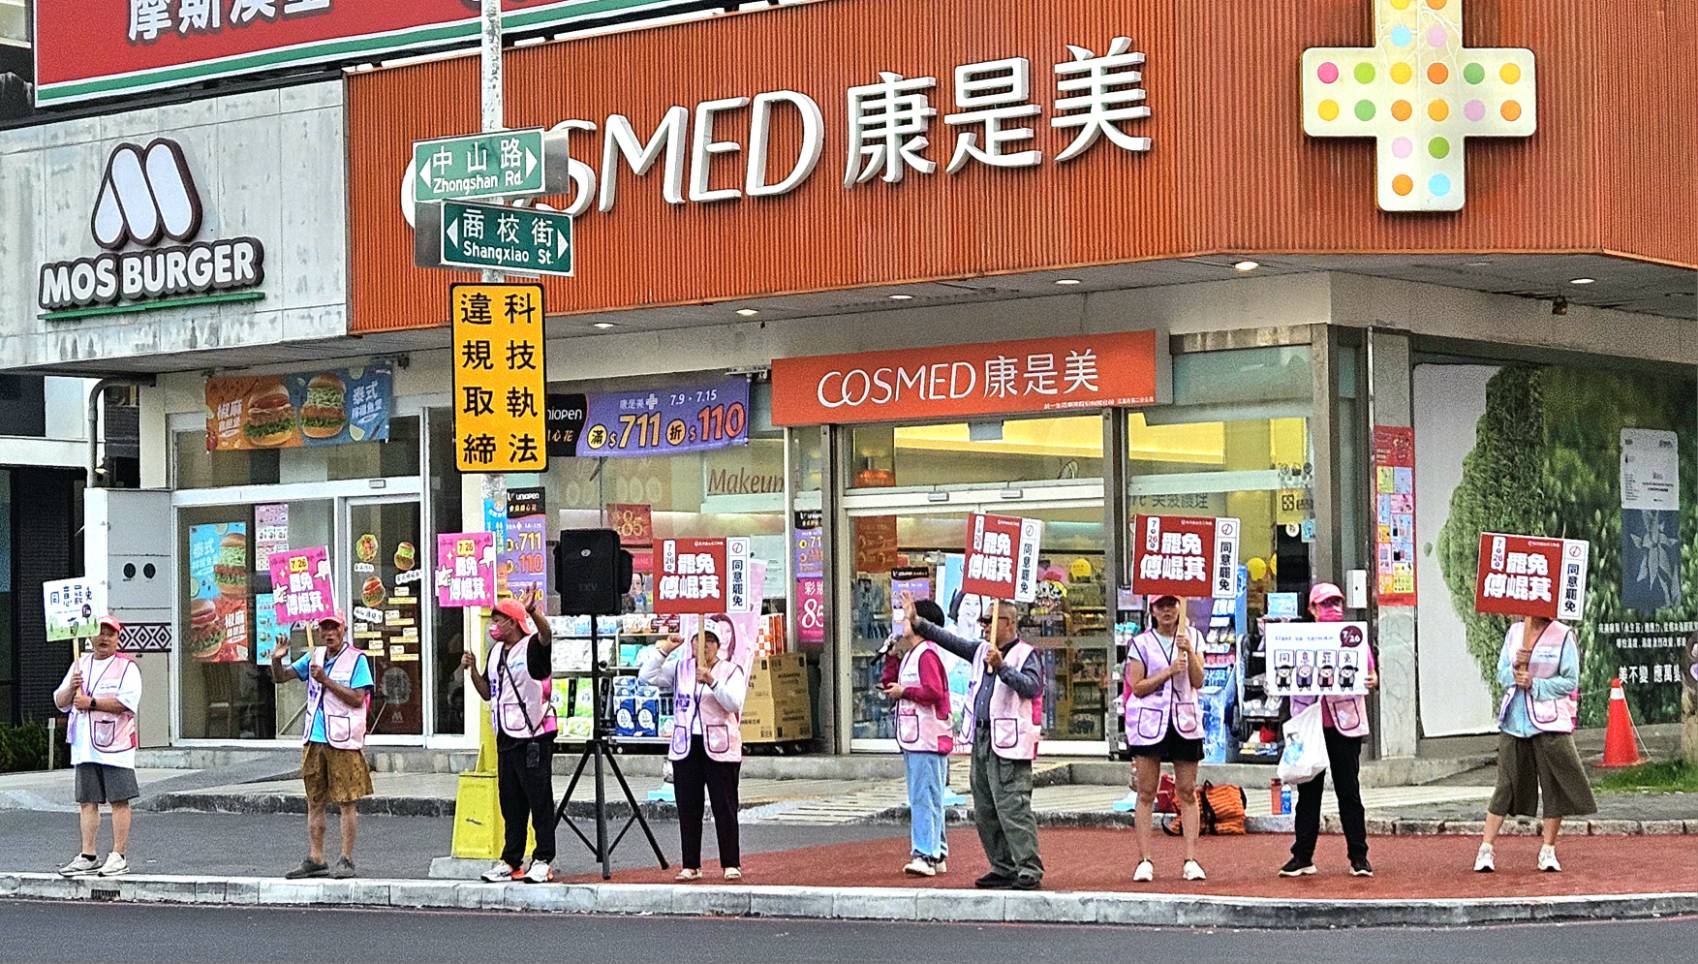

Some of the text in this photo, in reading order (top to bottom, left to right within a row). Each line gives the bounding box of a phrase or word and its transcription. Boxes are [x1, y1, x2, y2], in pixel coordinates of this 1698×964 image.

[128, 0, 331, 41] 摩斯
[844, 36, 1151, 188] 康是美
[432, 138, 523, 176] 中山路
[433, 170, 524, 195] Zhongshan Rd.
[462, 208, 554, 248] 商校街
[463, 240, 554, 265] Shangxiao St.
[41, 243, 257, 305] MOS BURGER
[460, 292, 497, 465] 違規取締
[504, 292, 538, 463] 科技執法
[816, 361, 976, 409] COSMED
[983, 349, 1100, 398] 康是美
[731, 559, 744, 607] 同意罷免
[1019, 542, 1033, 595] 同意罷免
[1218, 541, 1233, 592] 同意罷免
[1563, 562, 1581, 613] 同意罷免
